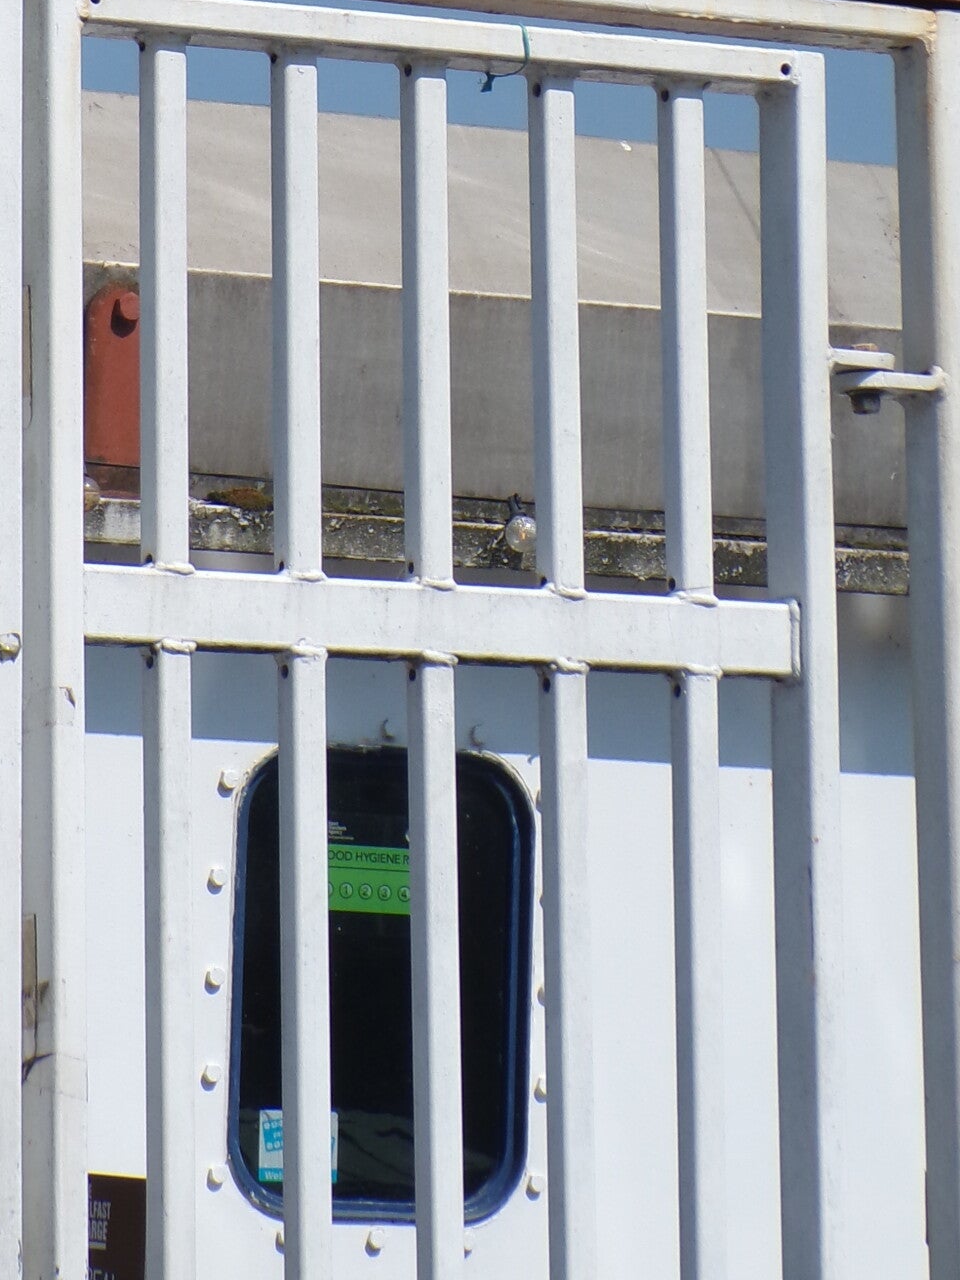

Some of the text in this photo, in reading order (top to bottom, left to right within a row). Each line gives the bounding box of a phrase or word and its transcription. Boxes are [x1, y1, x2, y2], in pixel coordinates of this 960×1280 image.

[328, 850, 353, 861] OOD
[355, 851, 400, 865] HYGIENE
[89, 1200, 112, 1220] LFAST
